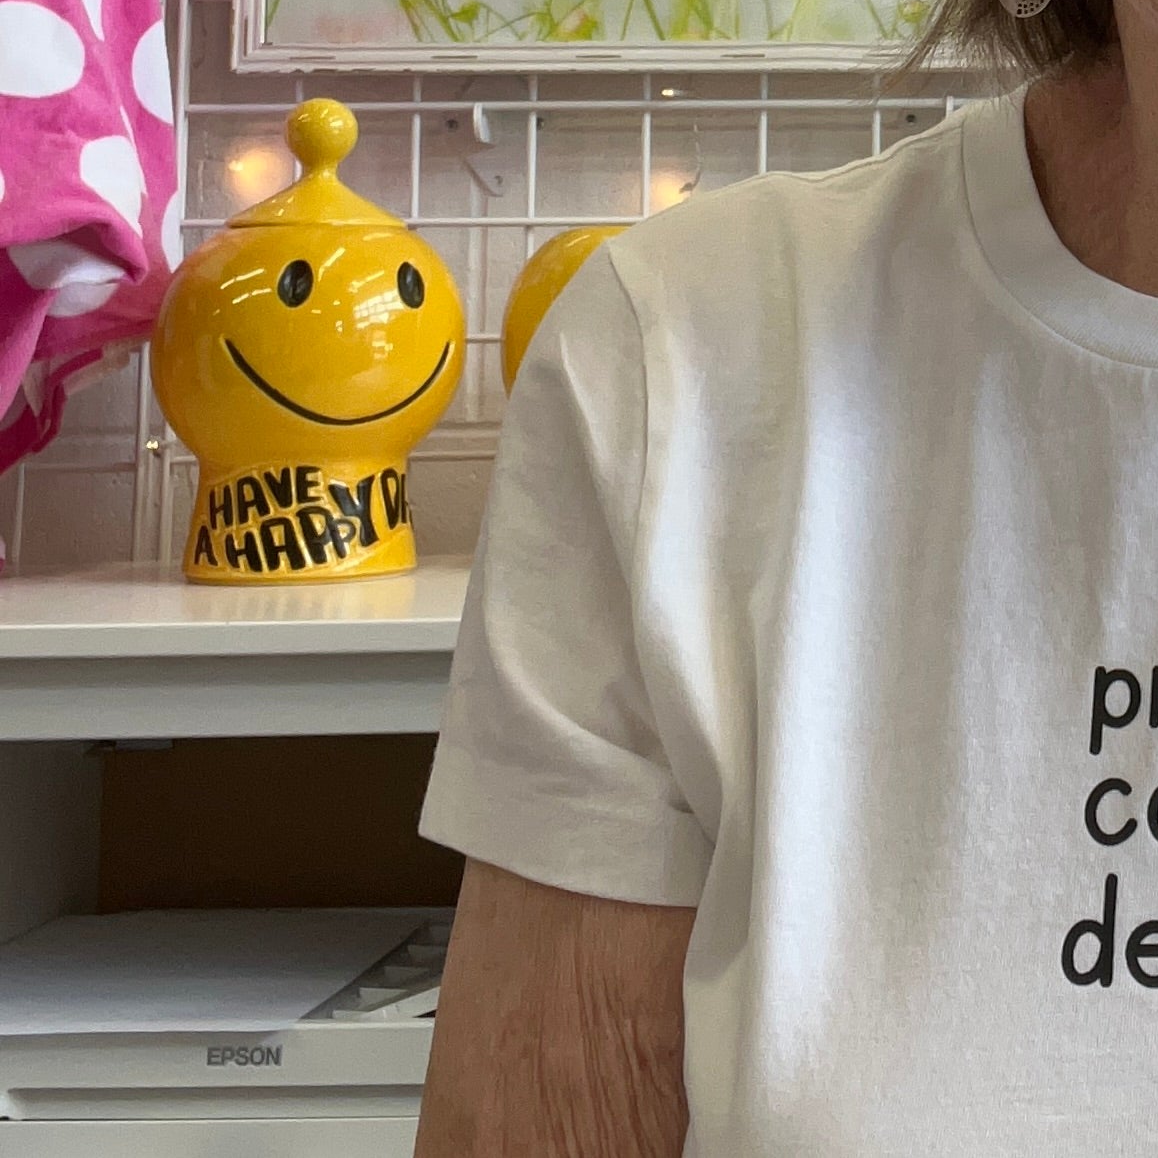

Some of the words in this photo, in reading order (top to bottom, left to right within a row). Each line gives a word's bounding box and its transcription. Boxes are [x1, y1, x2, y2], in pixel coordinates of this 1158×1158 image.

[194, 525, 218, 567] A
[224, 474, 379, 572] HAPPY
[209, 465, 324, 530] HAVE
[207, 1046, 282, 1067] EPSON
